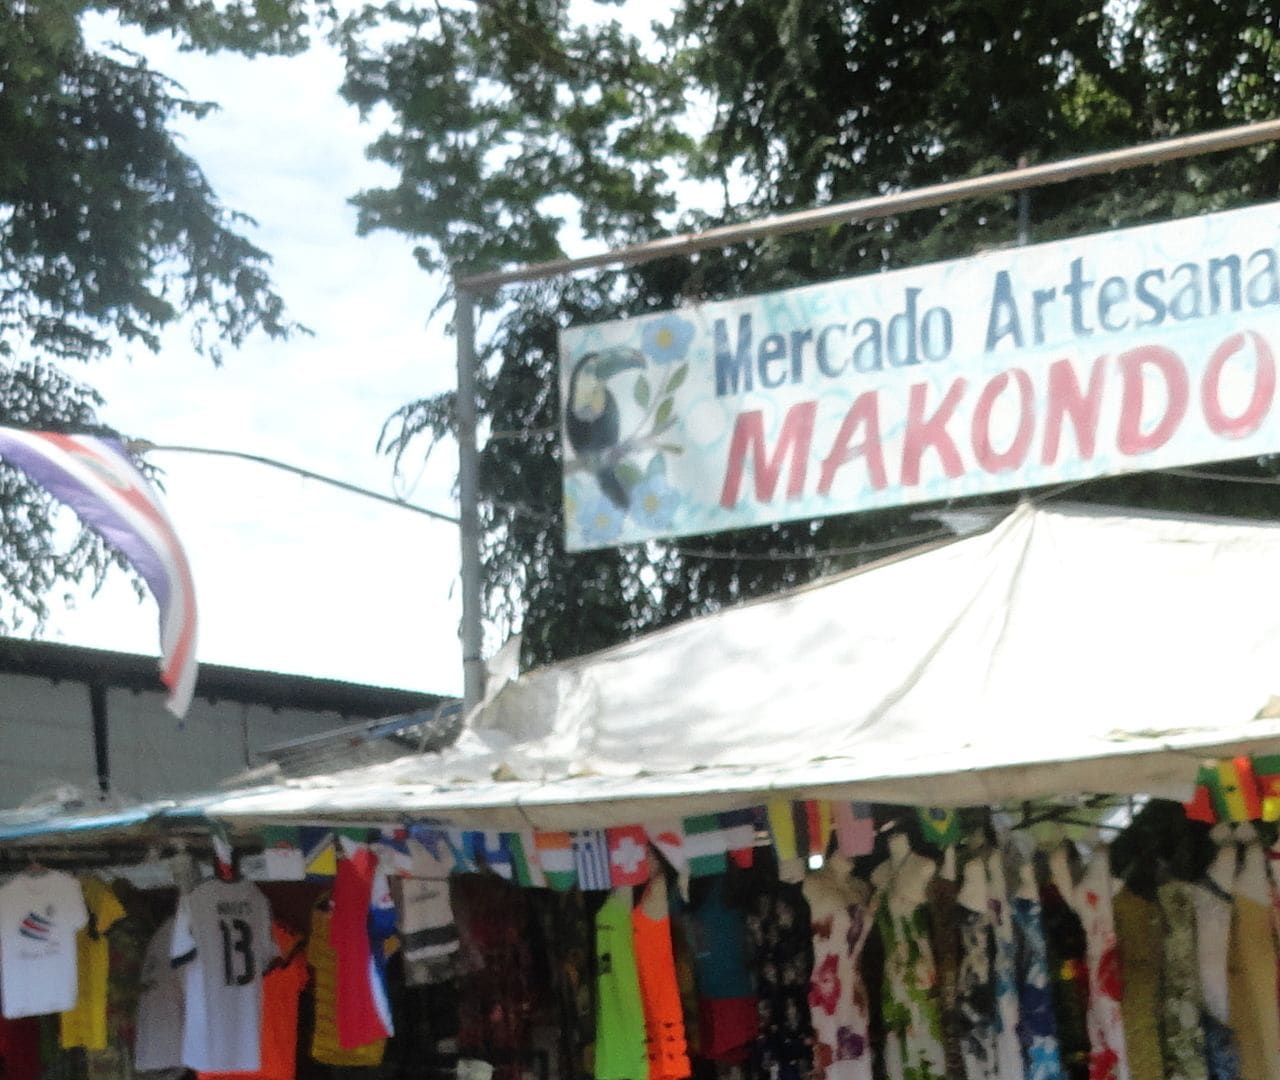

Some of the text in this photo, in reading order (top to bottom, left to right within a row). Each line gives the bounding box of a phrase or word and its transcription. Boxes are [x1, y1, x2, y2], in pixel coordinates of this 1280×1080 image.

[712, 286, 953, 398] Mercado
[719, 328, 1279, 511] MAKONDO
[218, 918, 256, 986] 13
